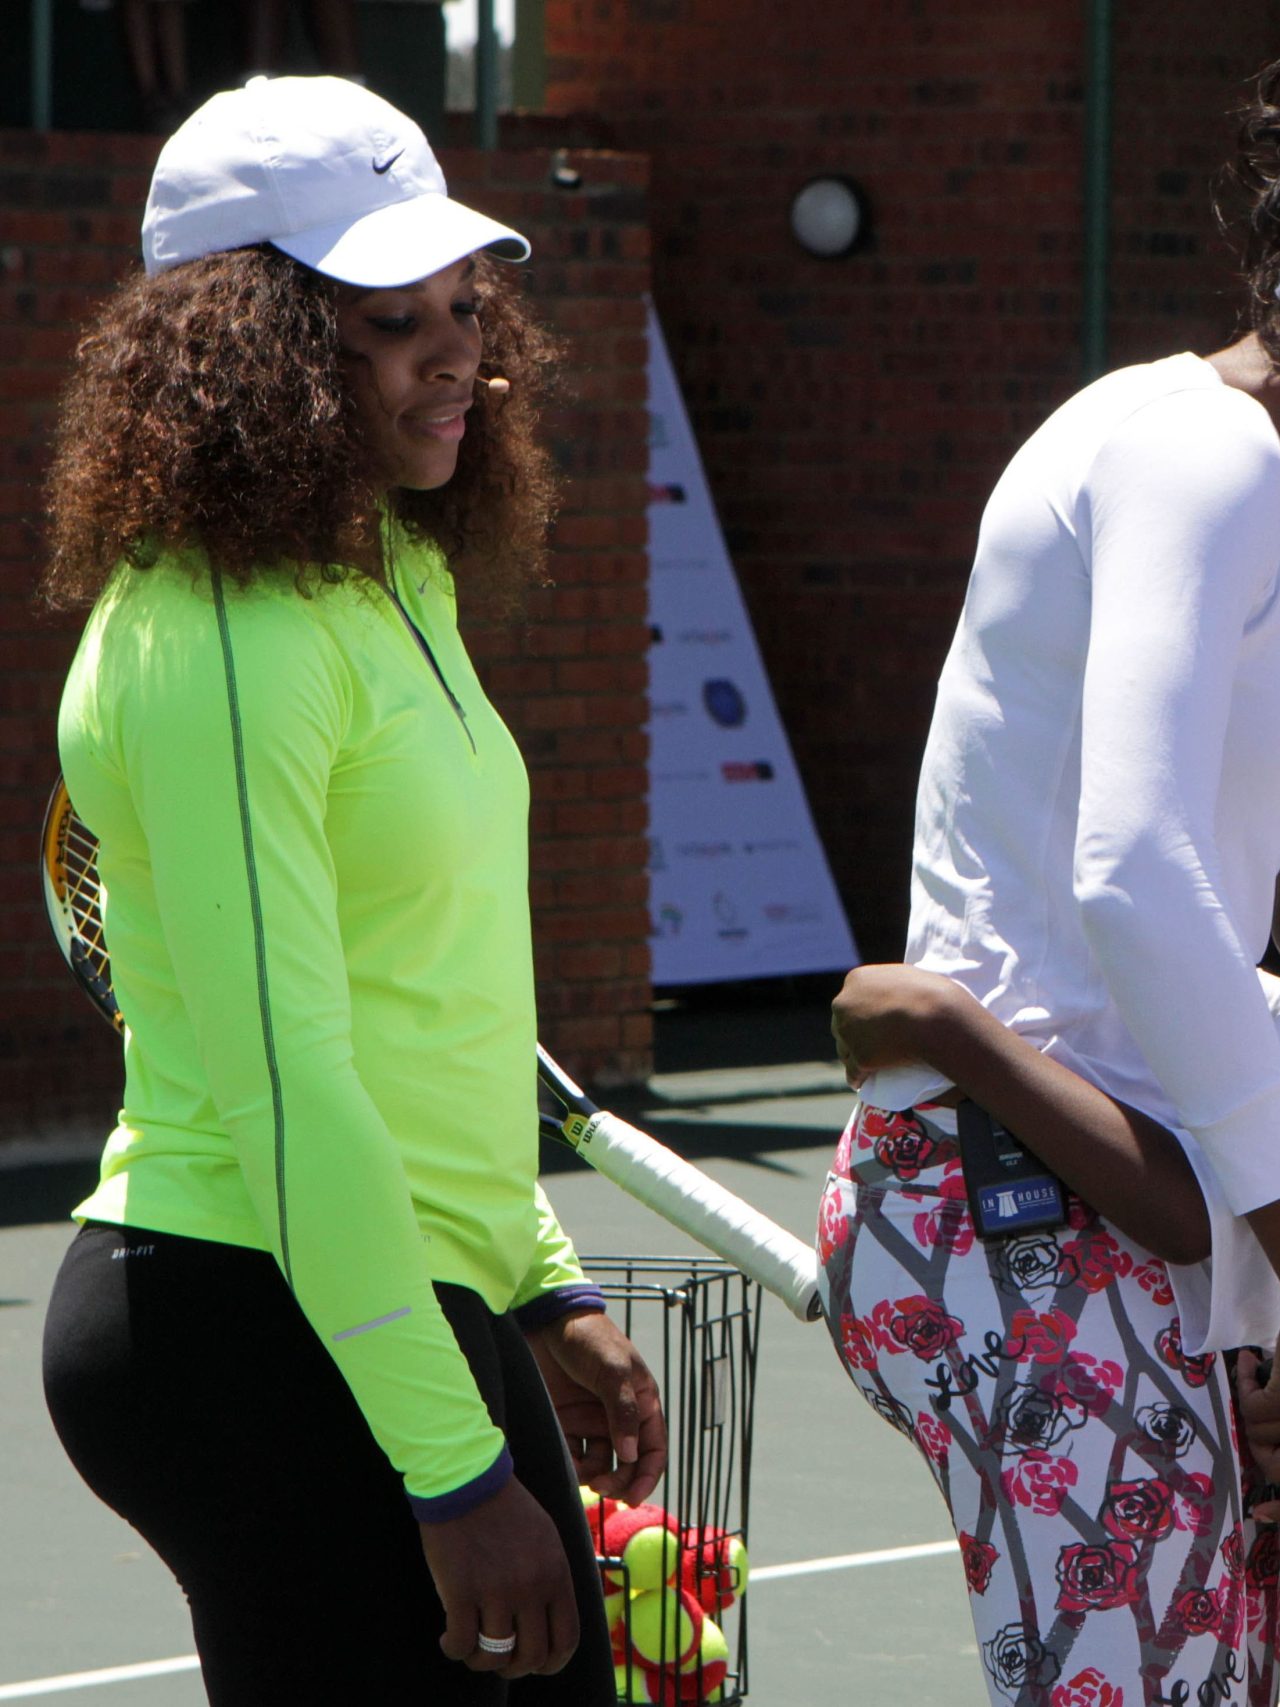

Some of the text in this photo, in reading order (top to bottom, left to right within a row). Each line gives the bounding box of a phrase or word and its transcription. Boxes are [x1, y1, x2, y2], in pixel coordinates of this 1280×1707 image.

[982, 1186, 1056, 1210] IN HOUSE
[111, 1244, 155, 1260] DRI-FIT
